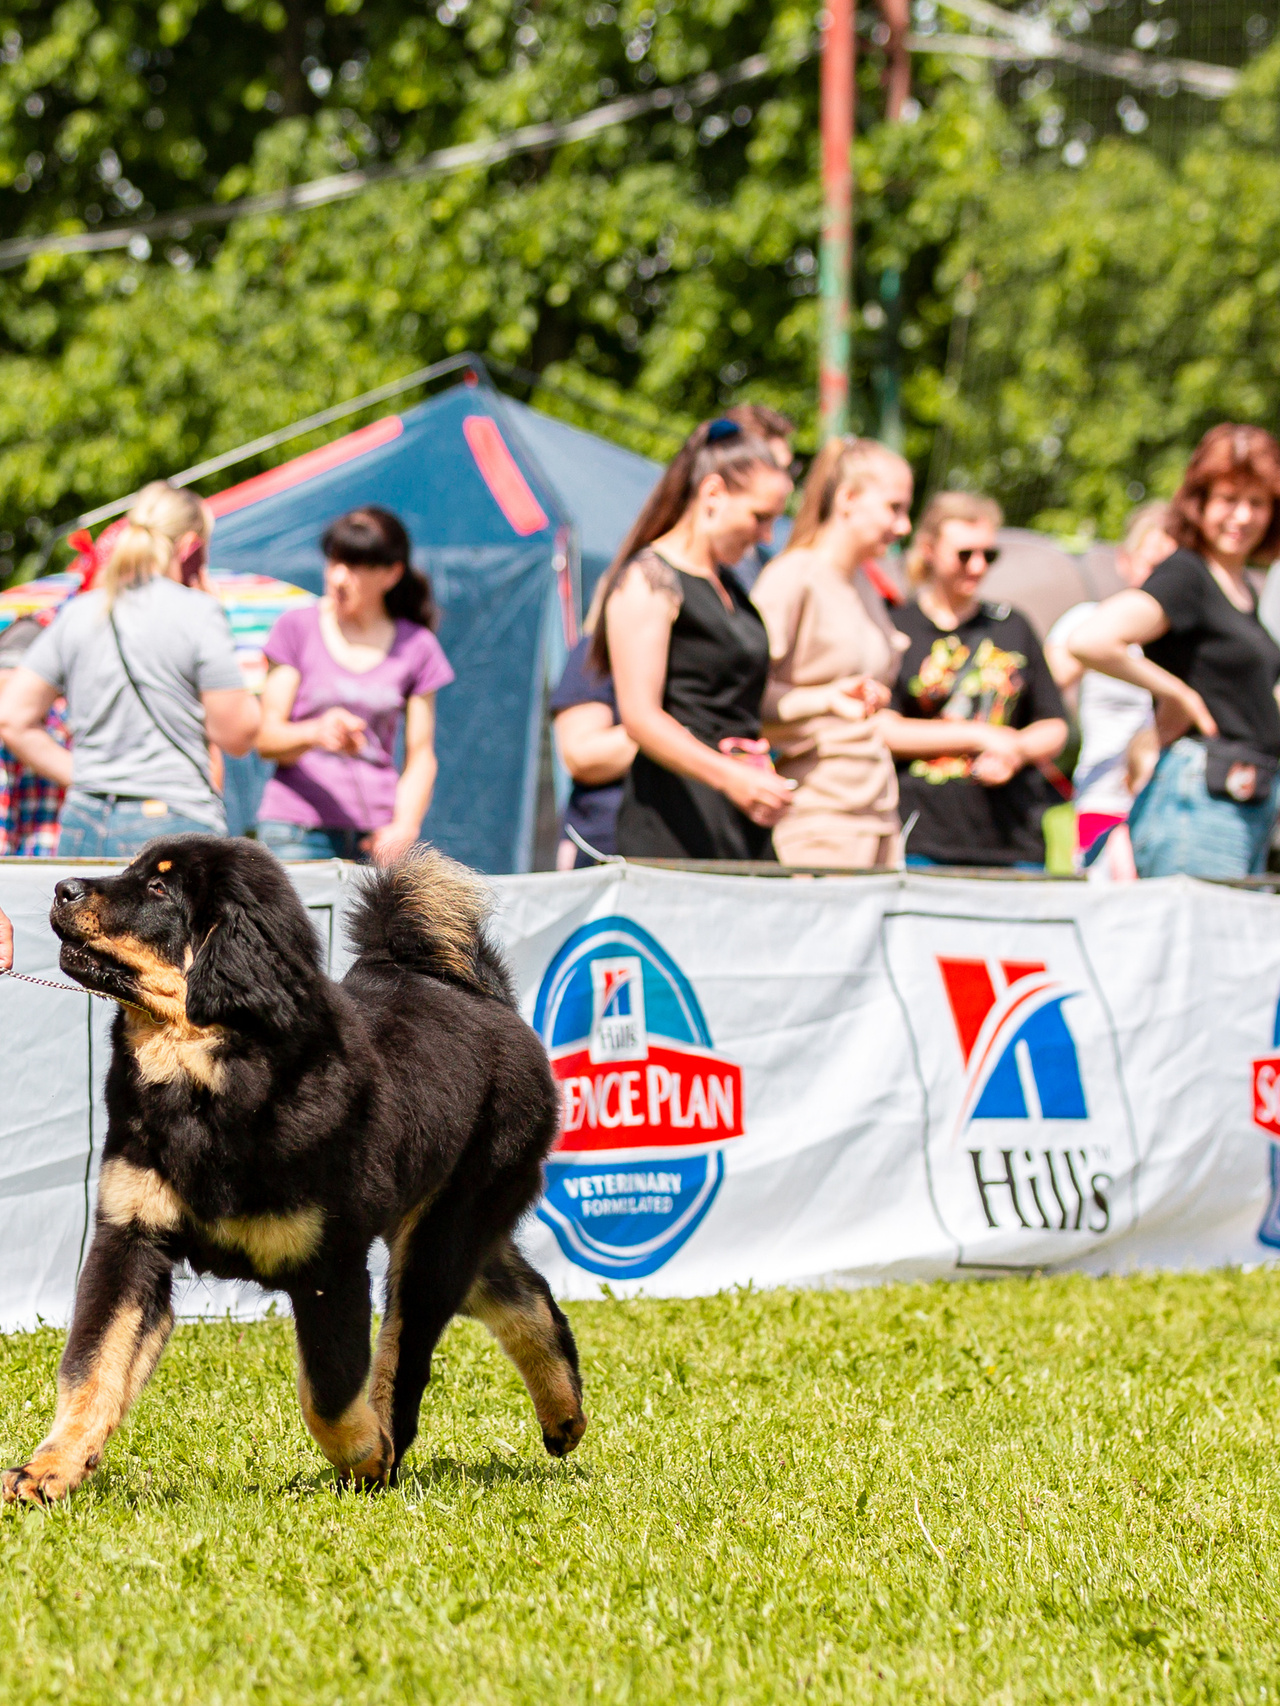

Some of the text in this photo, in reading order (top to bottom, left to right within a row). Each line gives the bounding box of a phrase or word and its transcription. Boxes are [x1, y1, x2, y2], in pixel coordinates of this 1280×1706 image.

[562, 1064, 735, 1133] ENCE PLAN
[563, 1171, 682, 1199] VETERINARY
[968, 1149, 1114, 1234] Hill's
